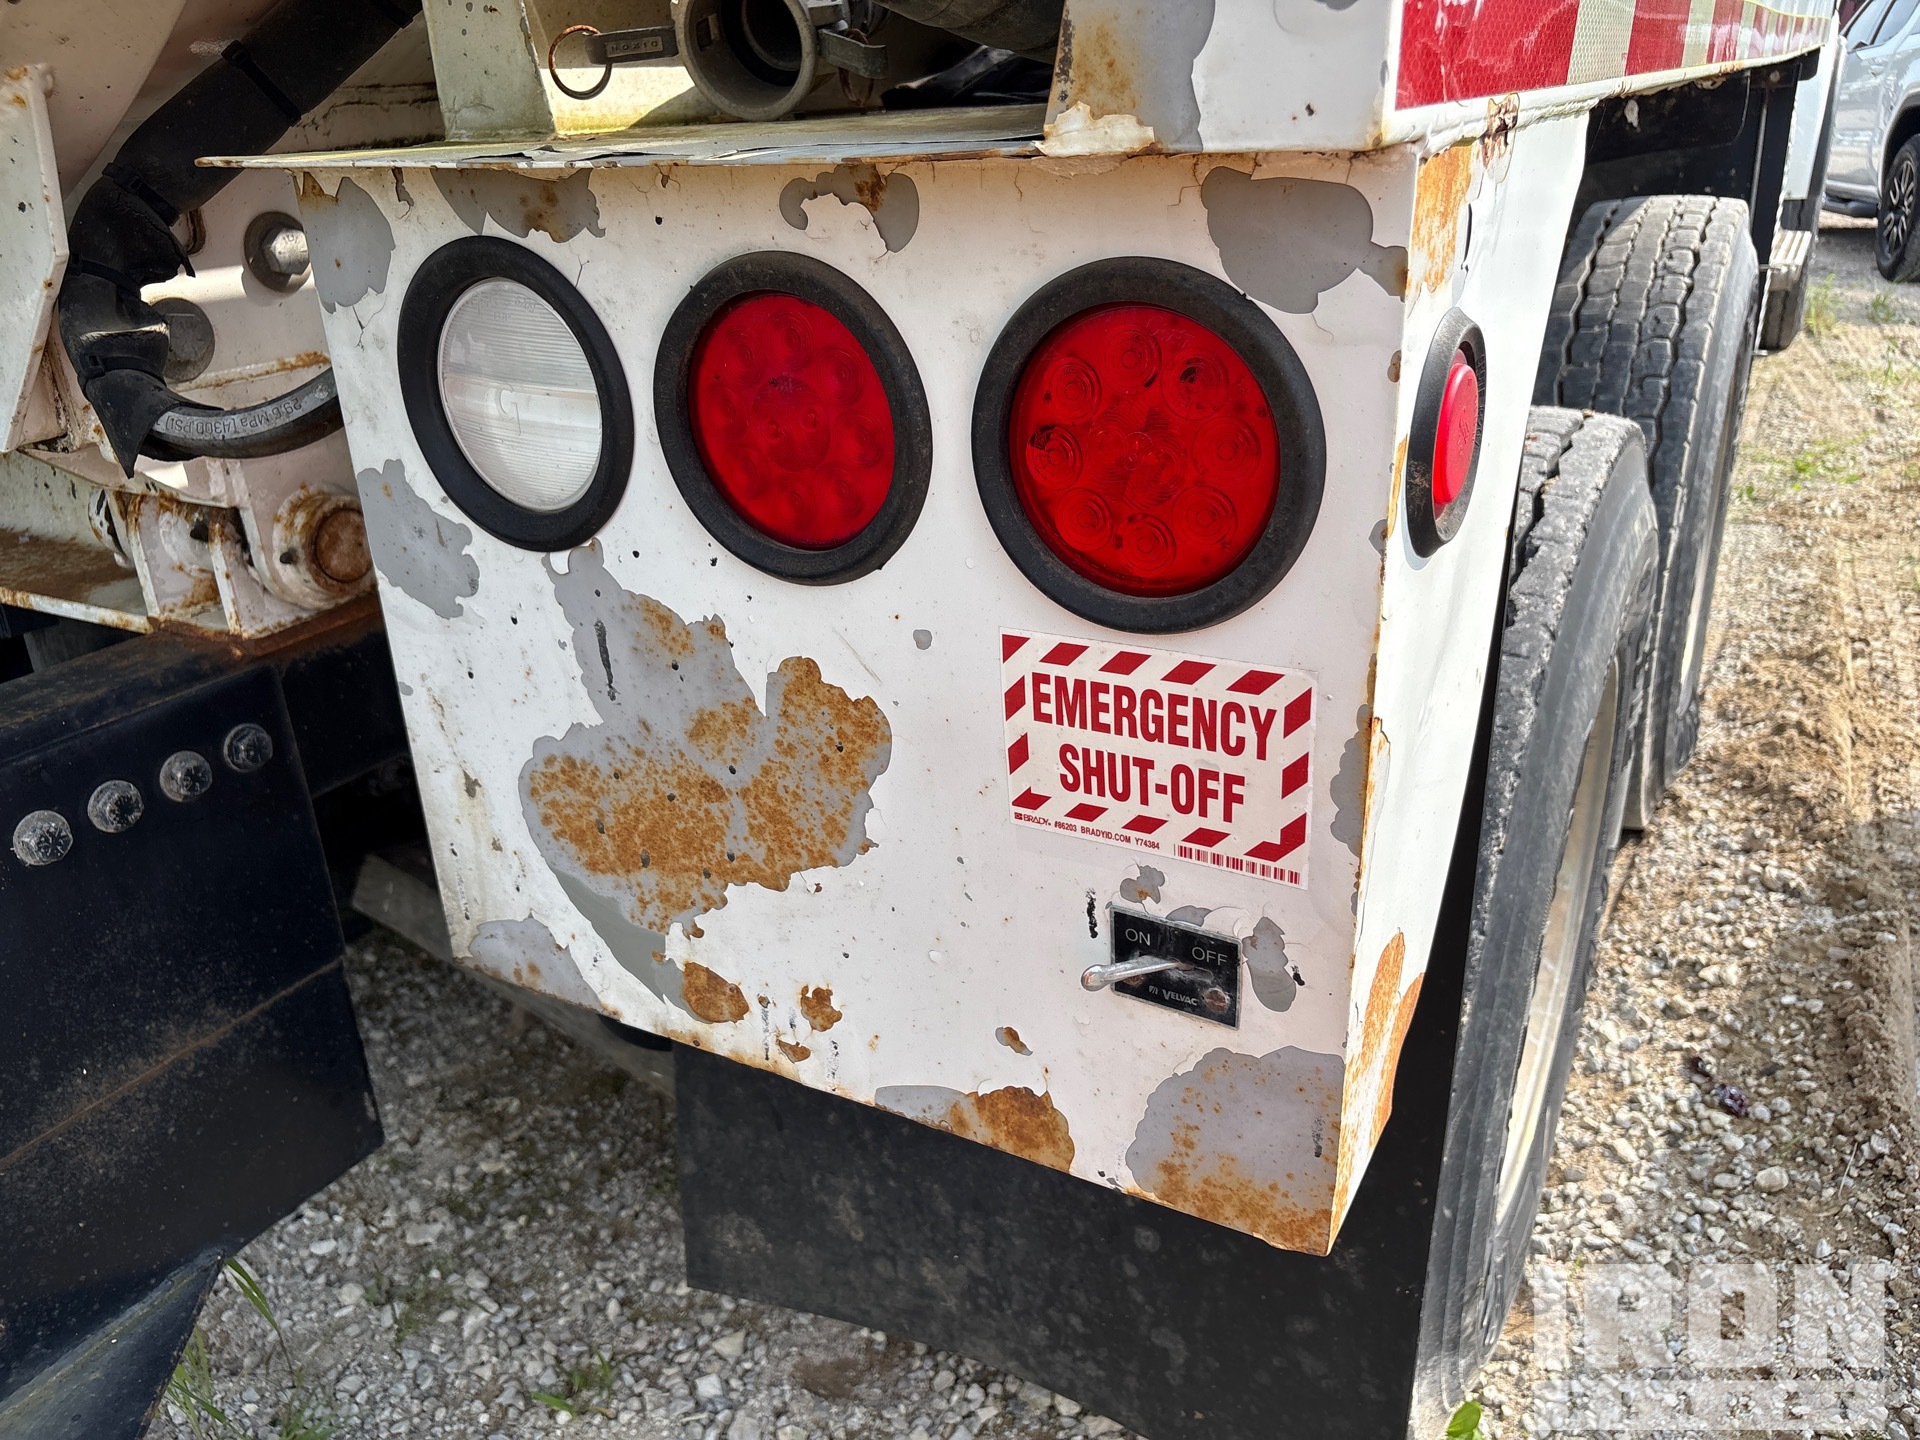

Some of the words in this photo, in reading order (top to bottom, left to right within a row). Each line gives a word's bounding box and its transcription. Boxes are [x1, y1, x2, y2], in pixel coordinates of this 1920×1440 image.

[240, 411, 270, 429] MPa
[1032, 672, 1277, 761] EMERGENCY
[1059, 744, 1245, 823] SHUT-OFF
[1055, 821, 1077, 831] #86203
[1081, 826, 1131, 843] BRADYID.COM
[1135, 837, 1160, 850] Y74384
[1124, 928, 1152, 946] ON
[1191, 946, 1229, 966] OFF
